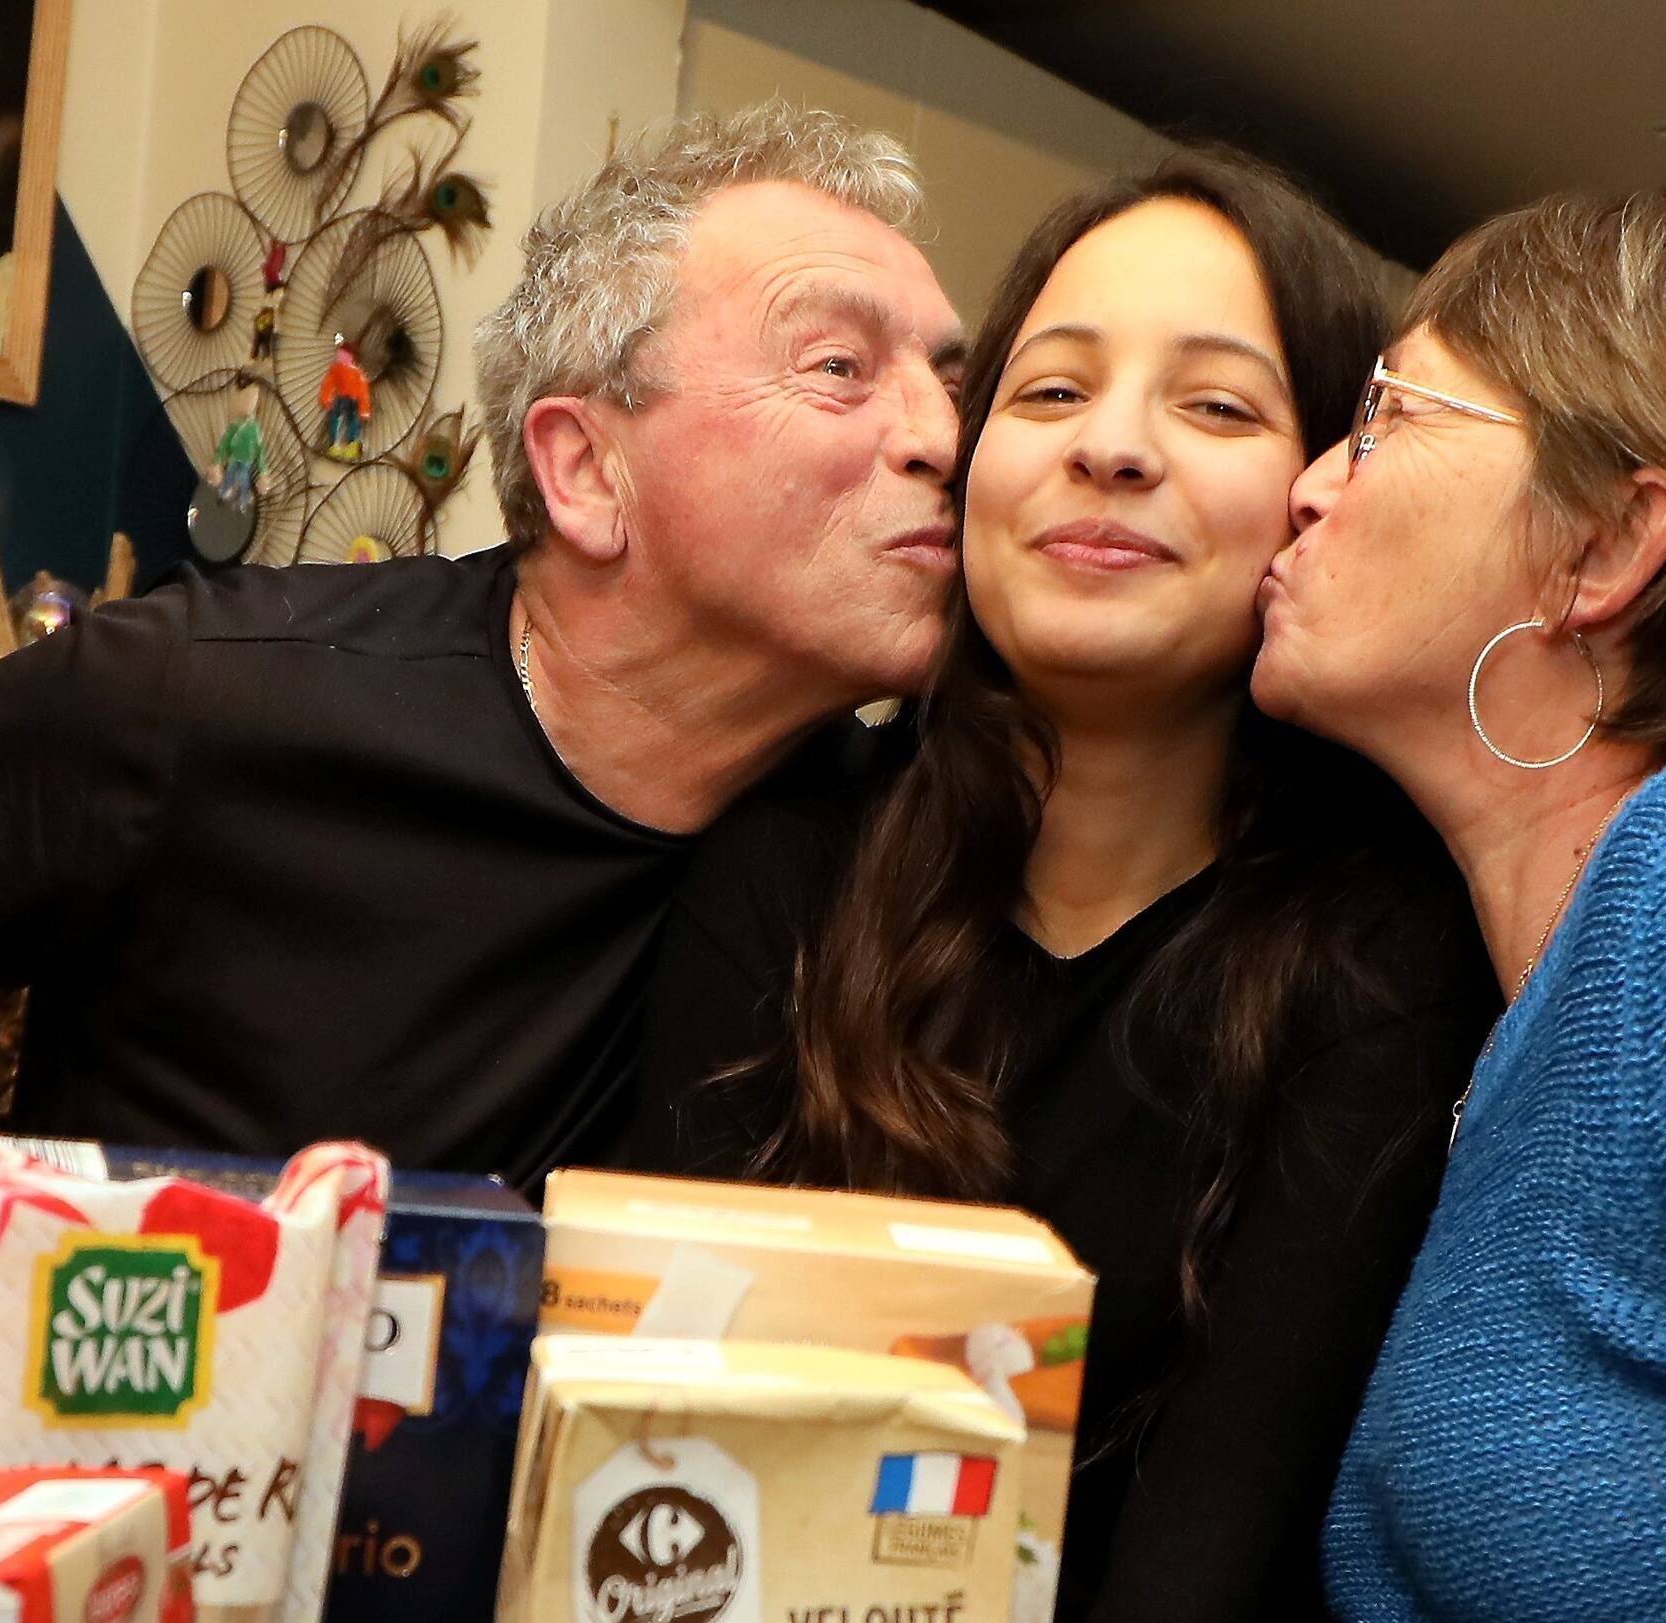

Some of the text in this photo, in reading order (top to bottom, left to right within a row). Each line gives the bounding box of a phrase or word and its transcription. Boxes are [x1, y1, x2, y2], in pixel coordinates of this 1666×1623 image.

[52, 1264, 191, 1339] Suzi
[541, 1279, 561, 1307] 8
[51, 1336, 191, 1396] WAN
[334, 1518, 423, 1579] rio
